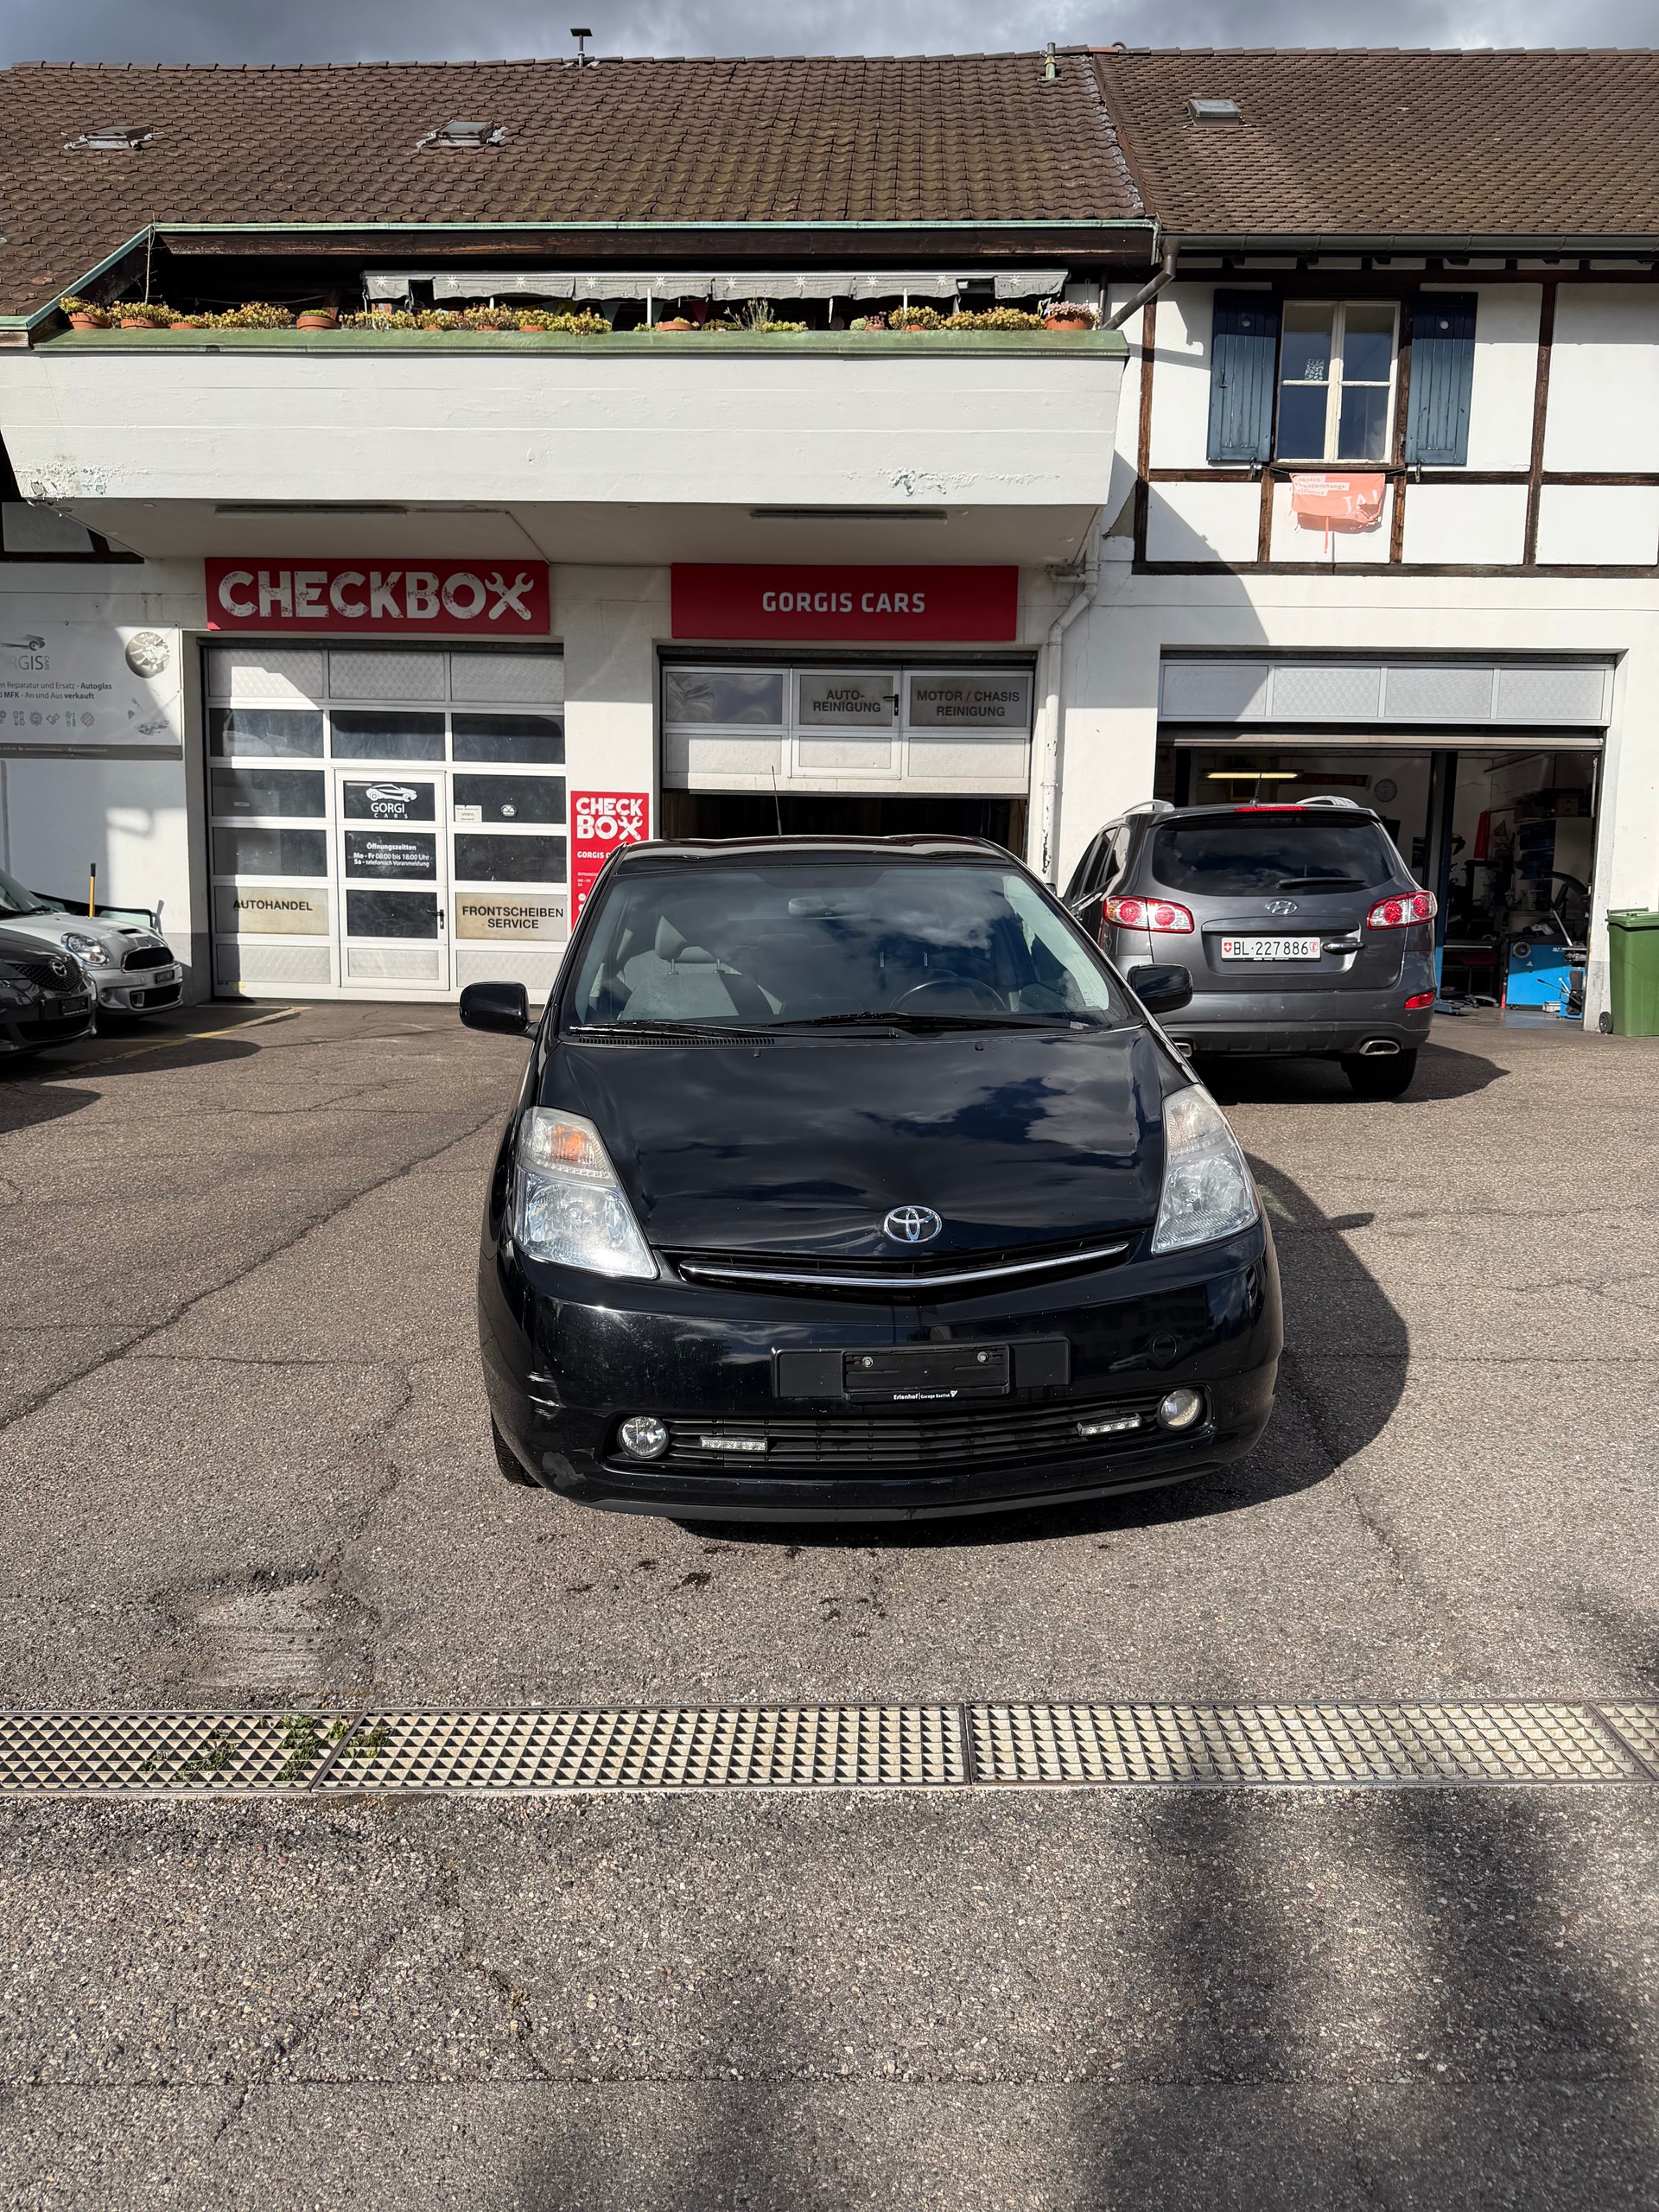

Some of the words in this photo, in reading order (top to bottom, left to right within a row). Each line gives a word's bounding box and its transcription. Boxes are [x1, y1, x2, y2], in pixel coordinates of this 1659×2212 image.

[219, 570, 534, 620] CHECKBOX
[762, 592, 853, 613] GORGIS
[861, 593, 925, 613] CARS
[7, 681, 39, 690] Reparatur
[826, 690, 865, 701] AUTO-
[917, 691, 963, 702] MOTOR
[975, 691, 1020, 702] CHASIS
[813, 701, 881, 714] REINIGUNG
[936, 706, 1006, 717] REINIGUNG
[371, 803, 405, 813] GORGI
[575, 797, 643, 817] CHECK
[576, 815, 643, 841] BOX
[233, 899, 314, 912] AUTOHANDEL
[462, 906, 564, 918] FRONTSCHEIBEN
[487, 918, 539, 929] SERVICE
